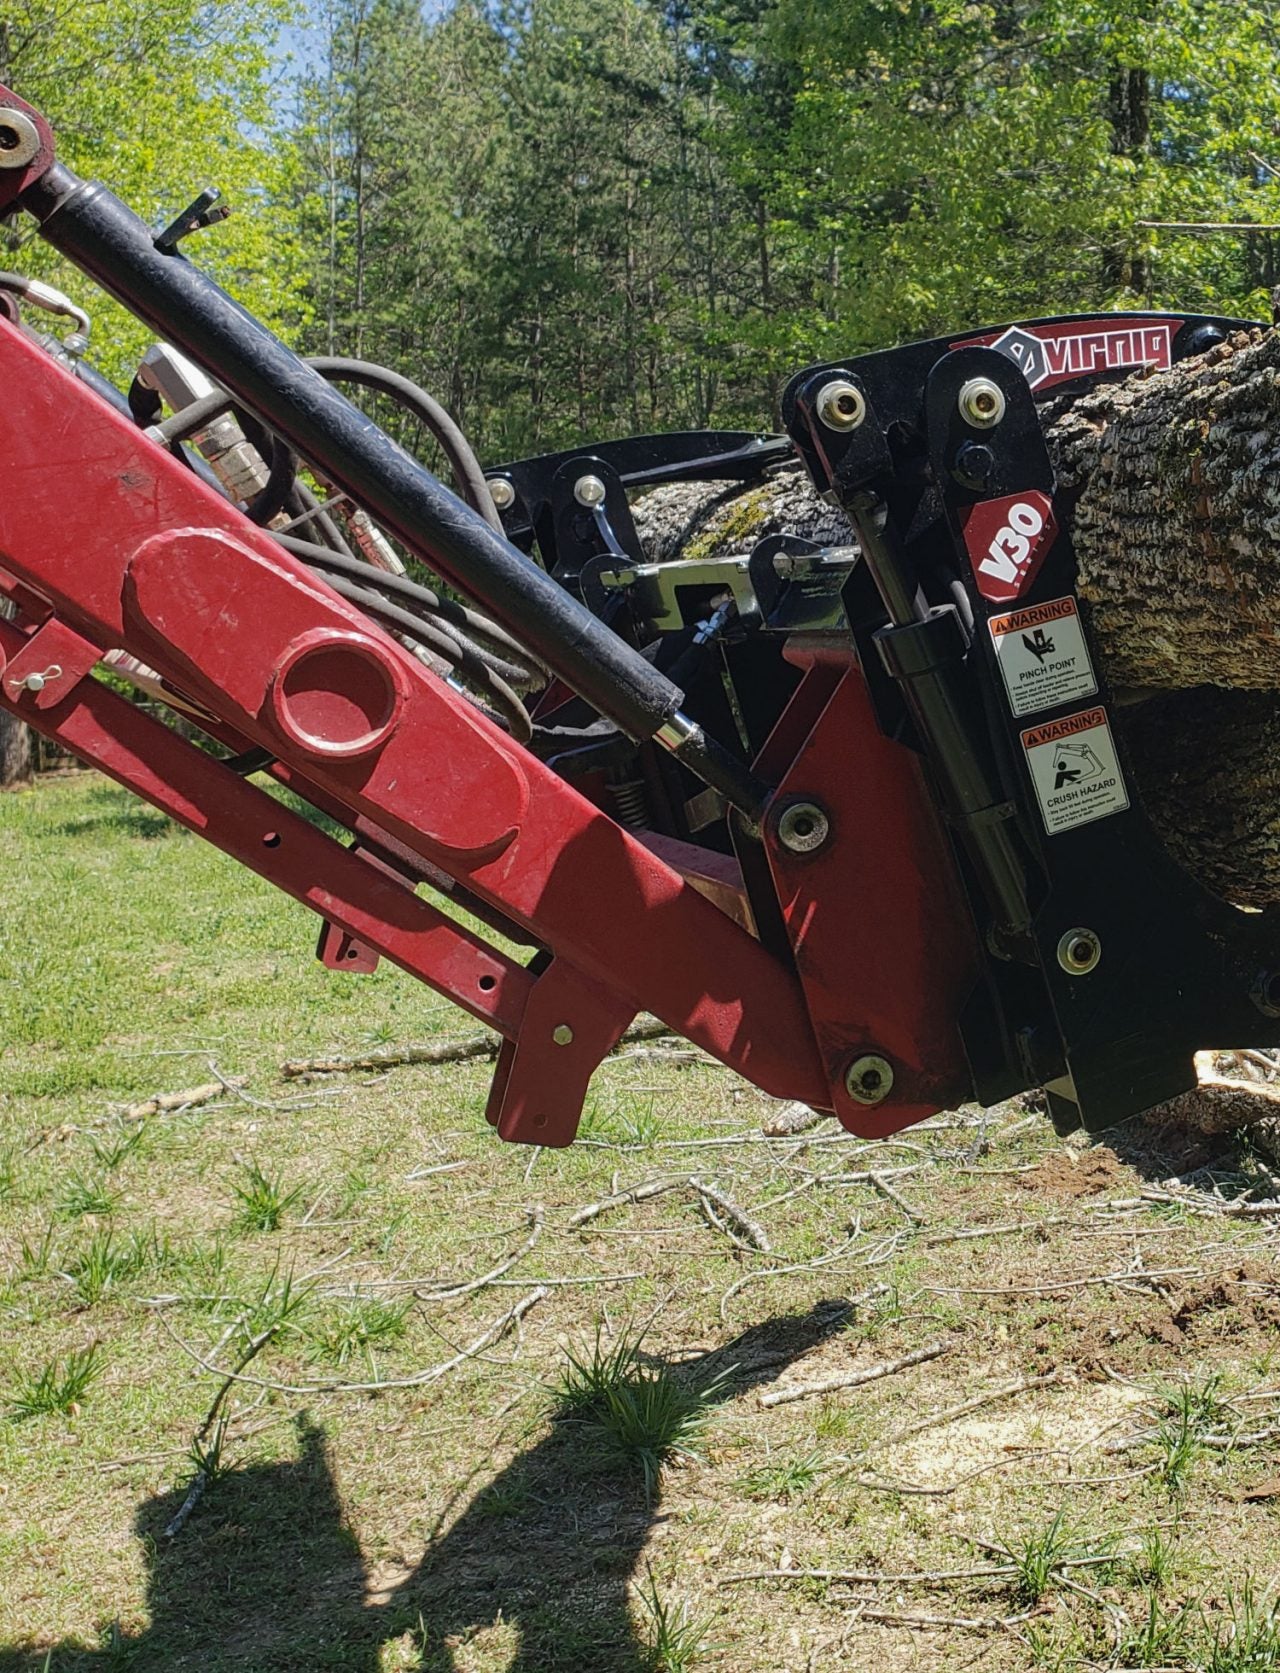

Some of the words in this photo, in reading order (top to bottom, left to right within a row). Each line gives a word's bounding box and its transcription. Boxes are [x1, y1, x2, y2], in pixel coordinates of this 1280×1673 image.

[978, 503, 1042, 583] V30
[1014, 524, 1051, 589] SERIES
[1007, 601, 1072, 629] WARNING
[1019, 665, 1048, 681] PINCH
[1049, 657, 1076, 672] POINT
[1037, 711, 1102, 740] WARNING
[1047, 791, 1079, 807] CRUSH
[1080, 778, 1116, 795] HAZARD
